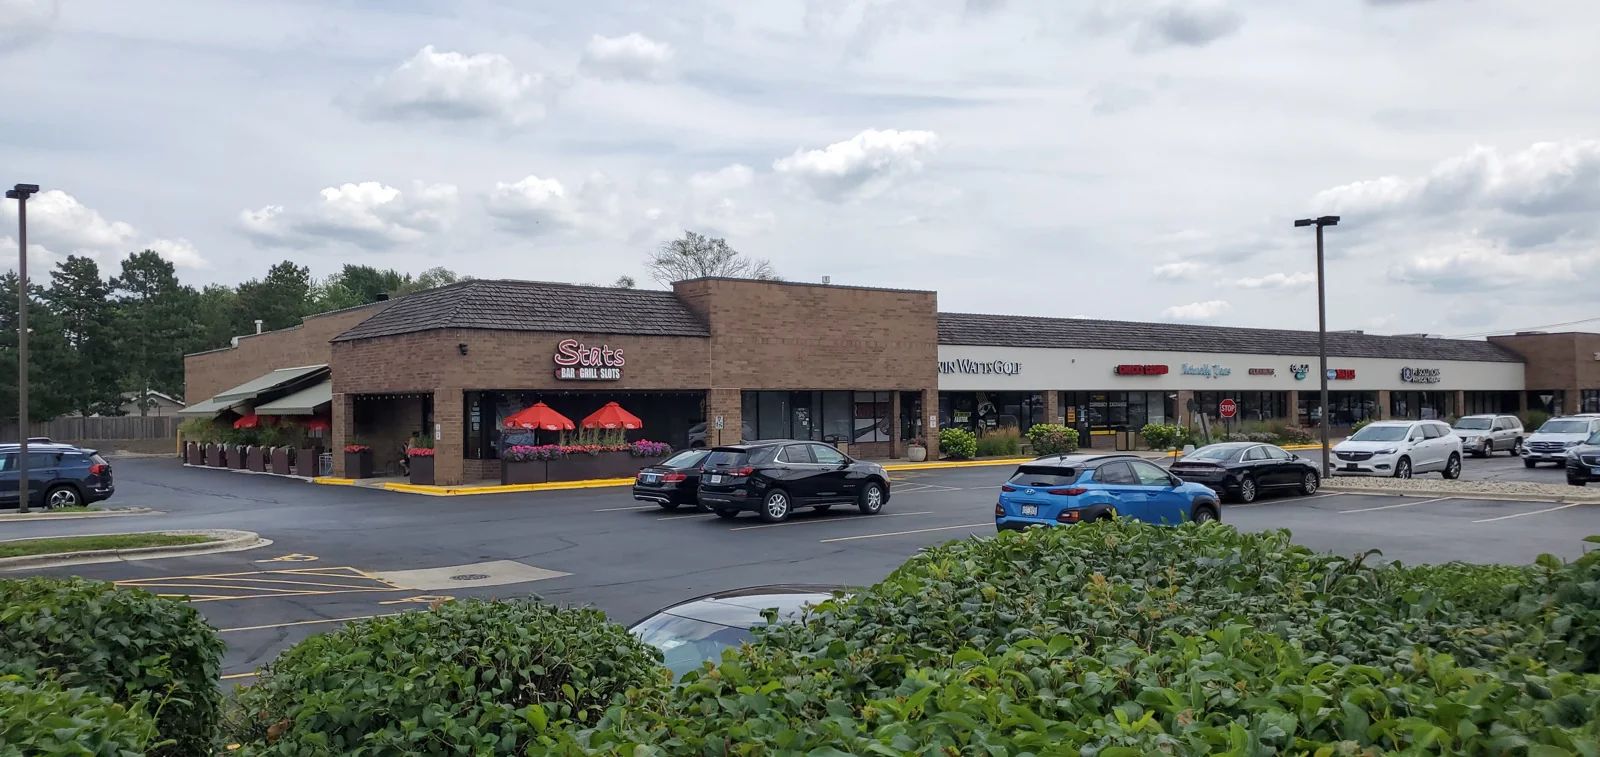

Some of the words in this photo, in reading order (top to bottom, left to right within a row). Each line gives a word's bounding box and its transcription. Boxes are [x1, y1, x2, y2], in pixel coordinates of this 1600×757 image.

[554, 338, 625, 367] Stats
[561, 367, 575, 378] BAR
[579, 367, 598, 379] GRILL
[600, 368, 620, 379] SLOTS
[1221, 404, 1235, 412] STOP
